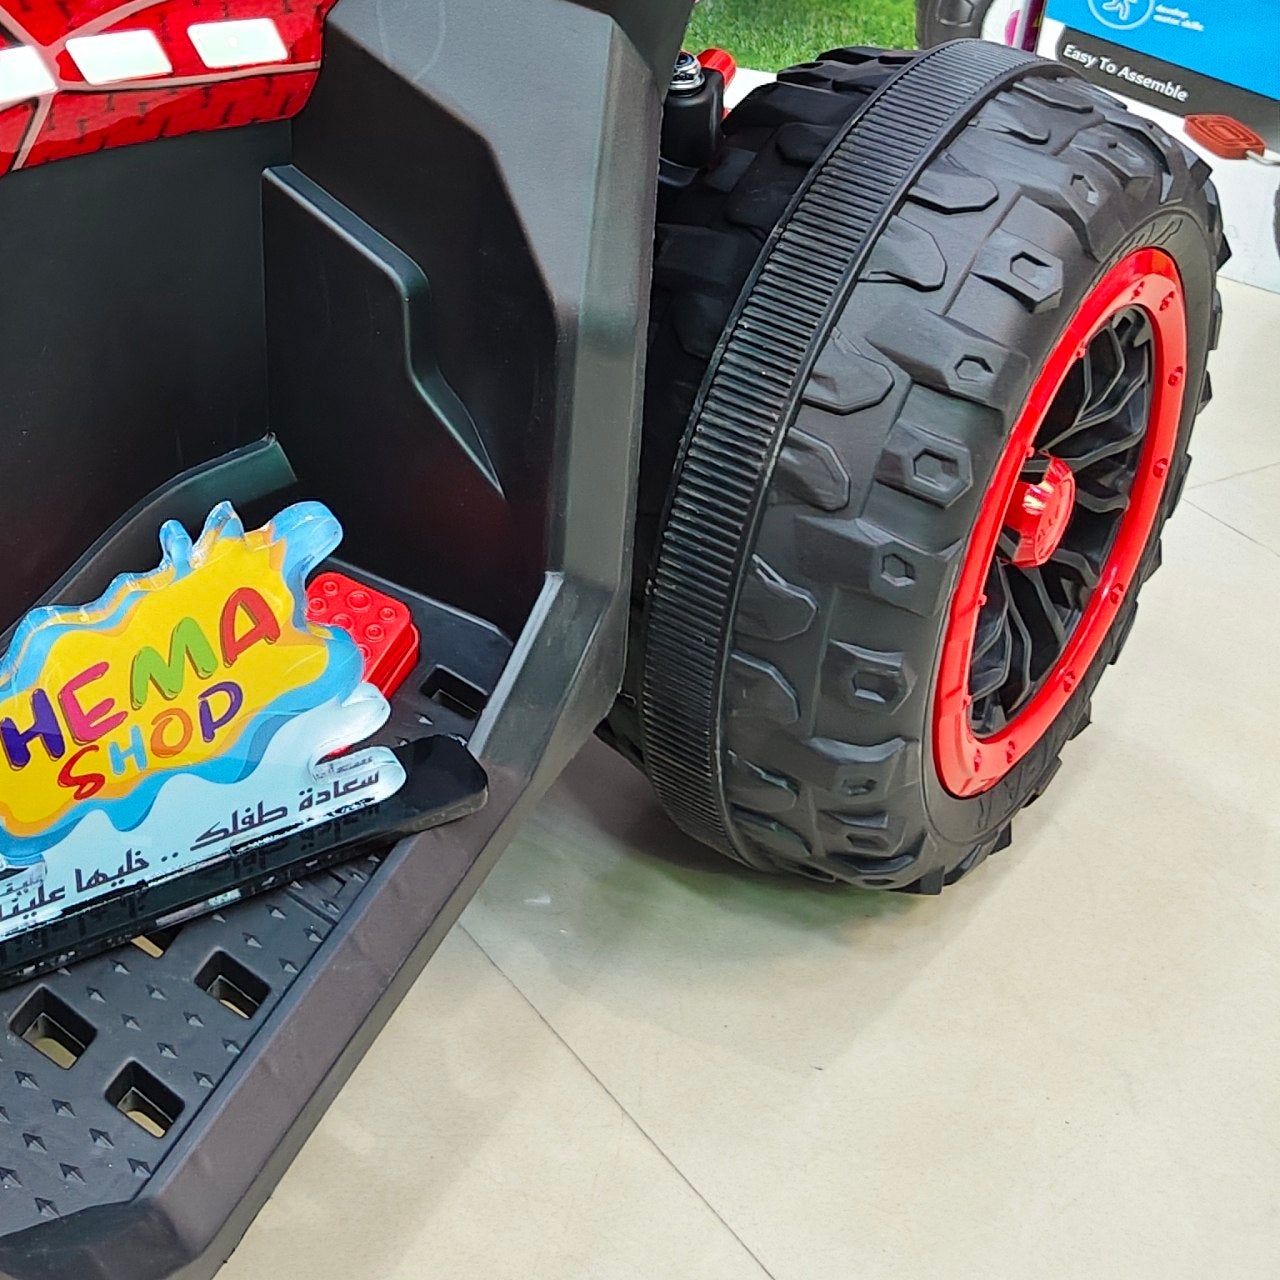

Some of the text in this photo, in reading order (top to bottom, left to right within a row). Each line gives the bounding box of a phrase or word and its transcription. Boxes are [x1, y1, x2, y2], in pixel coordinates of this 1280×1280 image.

[1062, 44, 1190, 103] Easy To Assemble
[57, 681, 243, 801] SHOP
[298, 770, 380, 812] سعادة
[189, 799, 288, 852] طفلك
[74, 847, 150, 894] خليها
